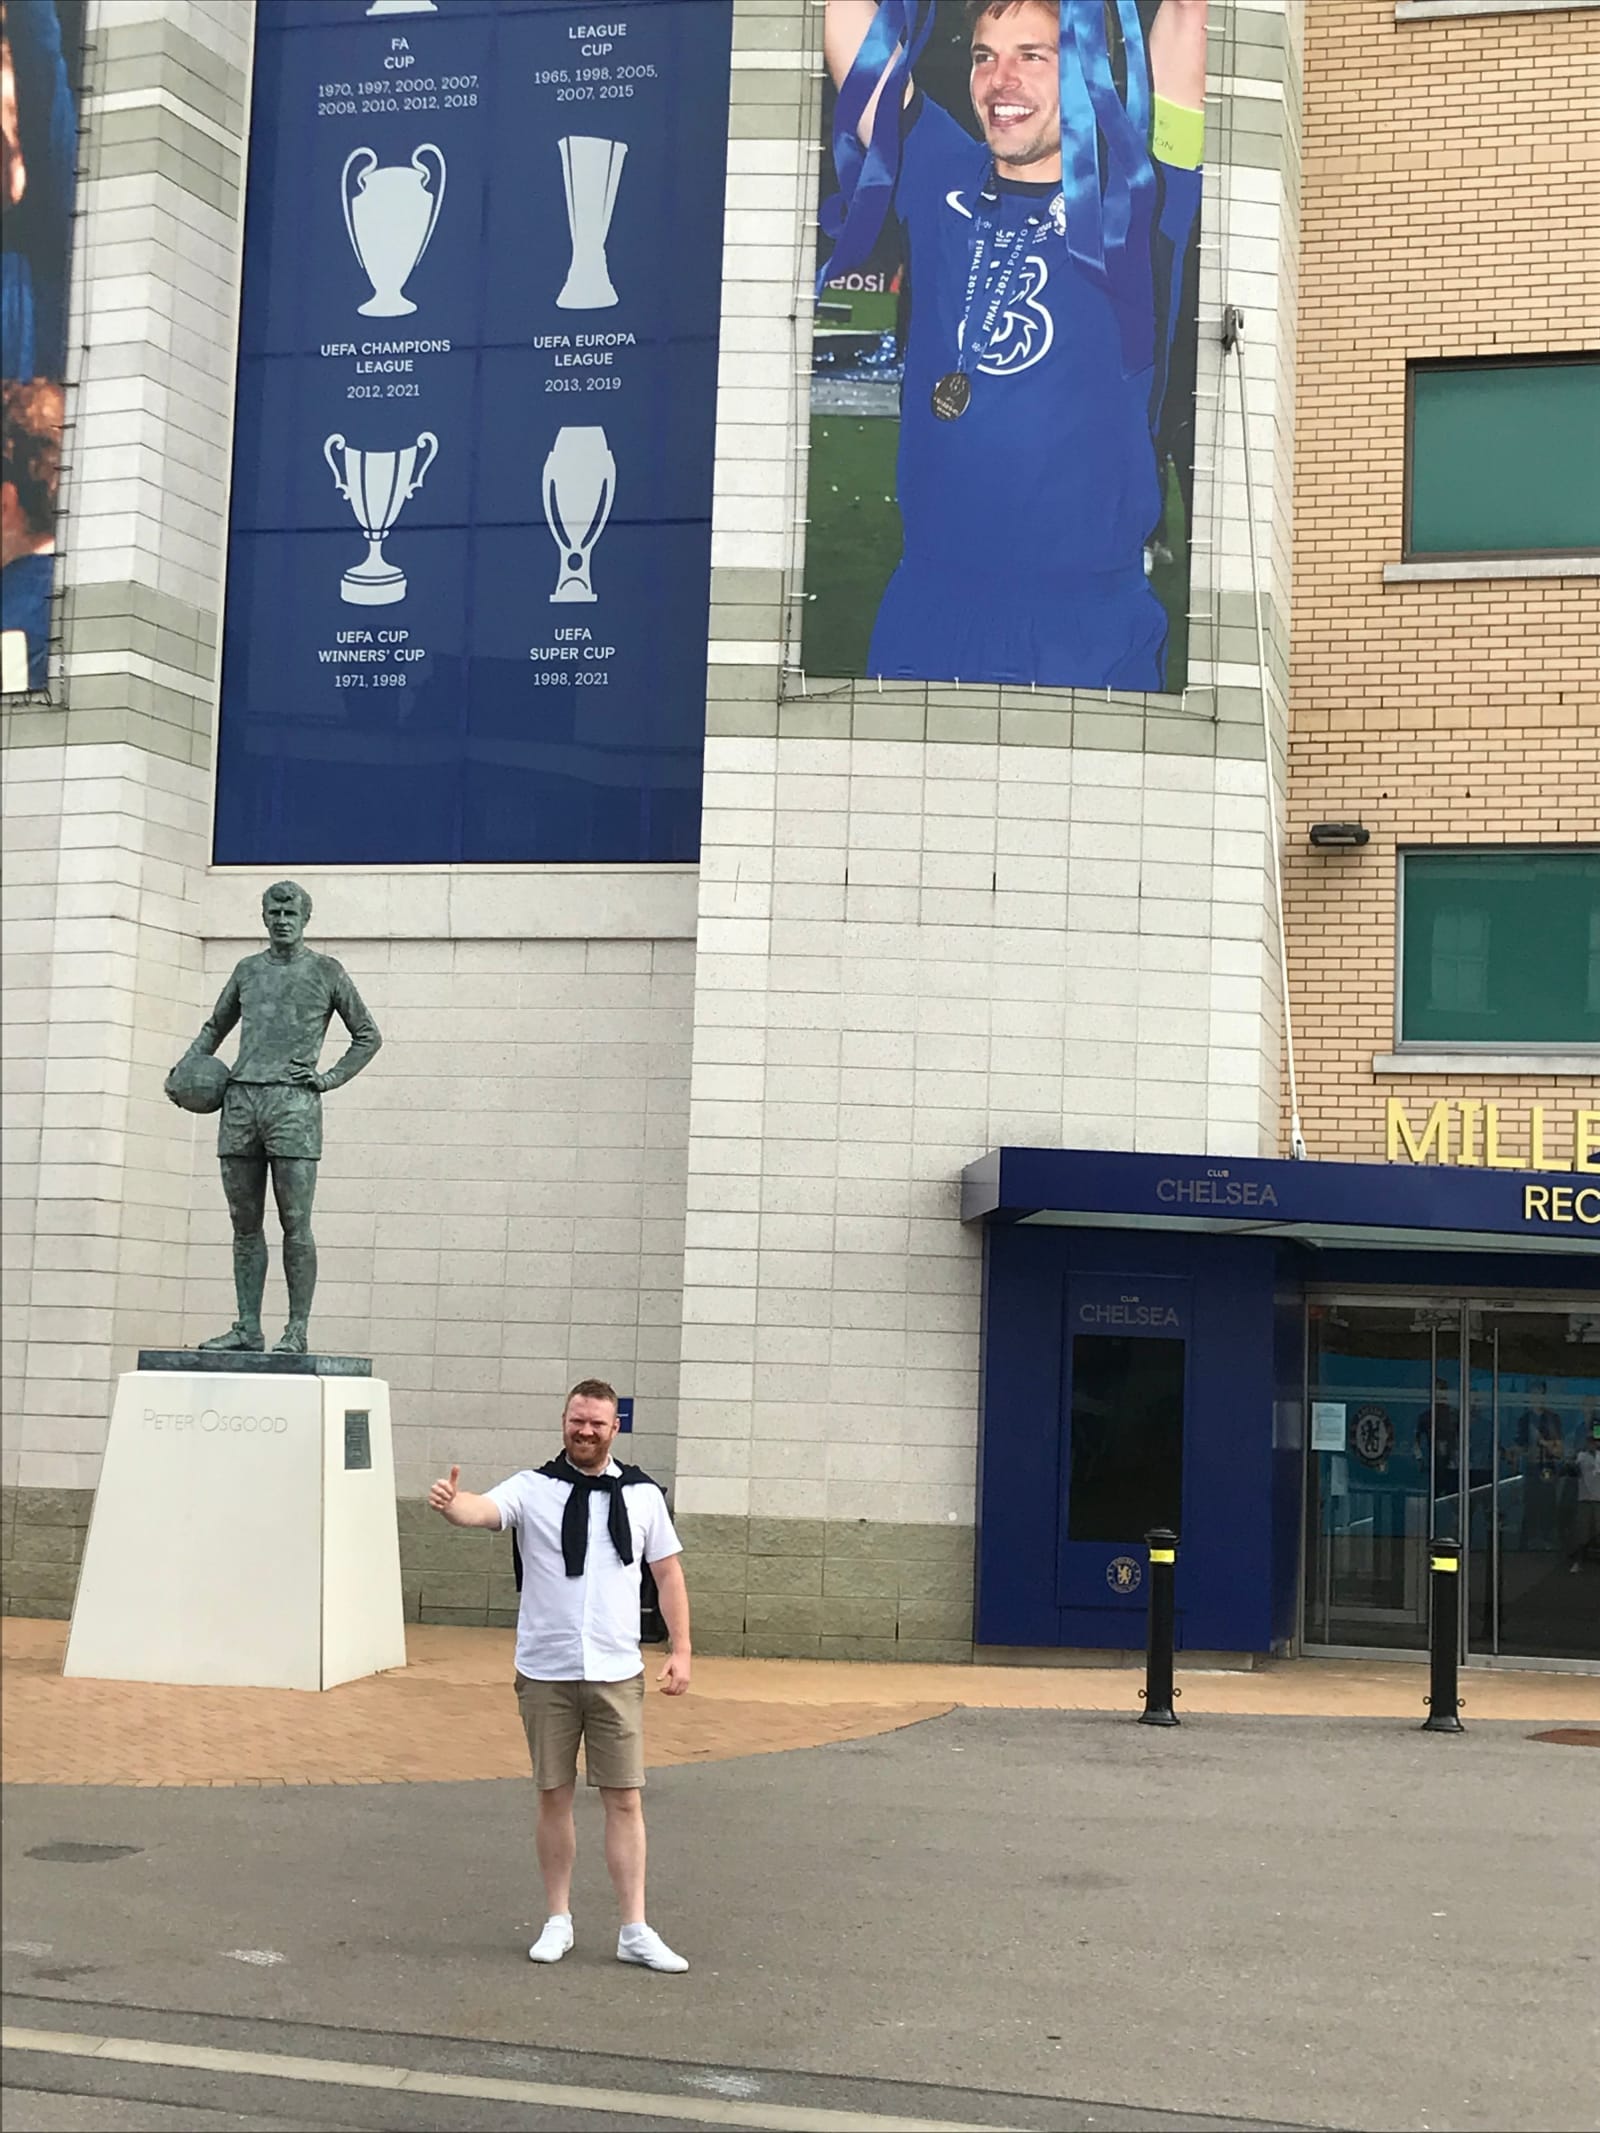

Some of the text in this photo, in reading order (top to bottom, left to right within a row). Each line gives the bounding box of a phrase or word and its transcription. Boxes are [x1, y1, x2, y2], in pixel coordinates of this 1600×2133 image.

[568, 23, 627, 39] LEAGUE
[391, 37, 410, 51] FA
[581, 42, 613, 57] CUP
[383, 55, 415, 70] CUP
[534, 64, 658, 84] 1965, 1998, 2005,
[318, 74, 479, 98] 1970, 1997, 2000, 2007,
[556, 84, 634, 102] 2007, 2015
[317, 93, 478, 116] 2009, 2010, 2012, 2018
[824, 272, 885, 293] epsi
[982, 299, 1001, 332] FINAL
[995, 269, 1013, 296] 2021
[1007, 228, 1028, 267] PORTO
[320, 339, 451, 357] UEFA CHAMPIONS
[533, 332, 636, 349] UEFA EUROPA
[356, 359, 414, 374] LEAGUE
[554, 352, 614, 367] LEAGUE
[346, 383, 420, 399] 2012, 2021
[544, 376, 622, 392] 2013, 2019
[336, 630, 409, 644] UEFA CUP
[554, 627, 593, 641] UEFA
[317, 648, 426, 663] WINNERS' CUP
[529, 646, 616, 661] SUPER CUP
[334, 673, 407, 688] 1971, 1998
[533, 671, 609, 686] 1998, 2021
[1386, 1097, 1600, 1174] MILLE
[1156, 1179, 1278, 1207] CHELSEA
[1524, 1184, 1600, 1224] REC
[1080, 1303, 1180, 1327] CHELSEA
